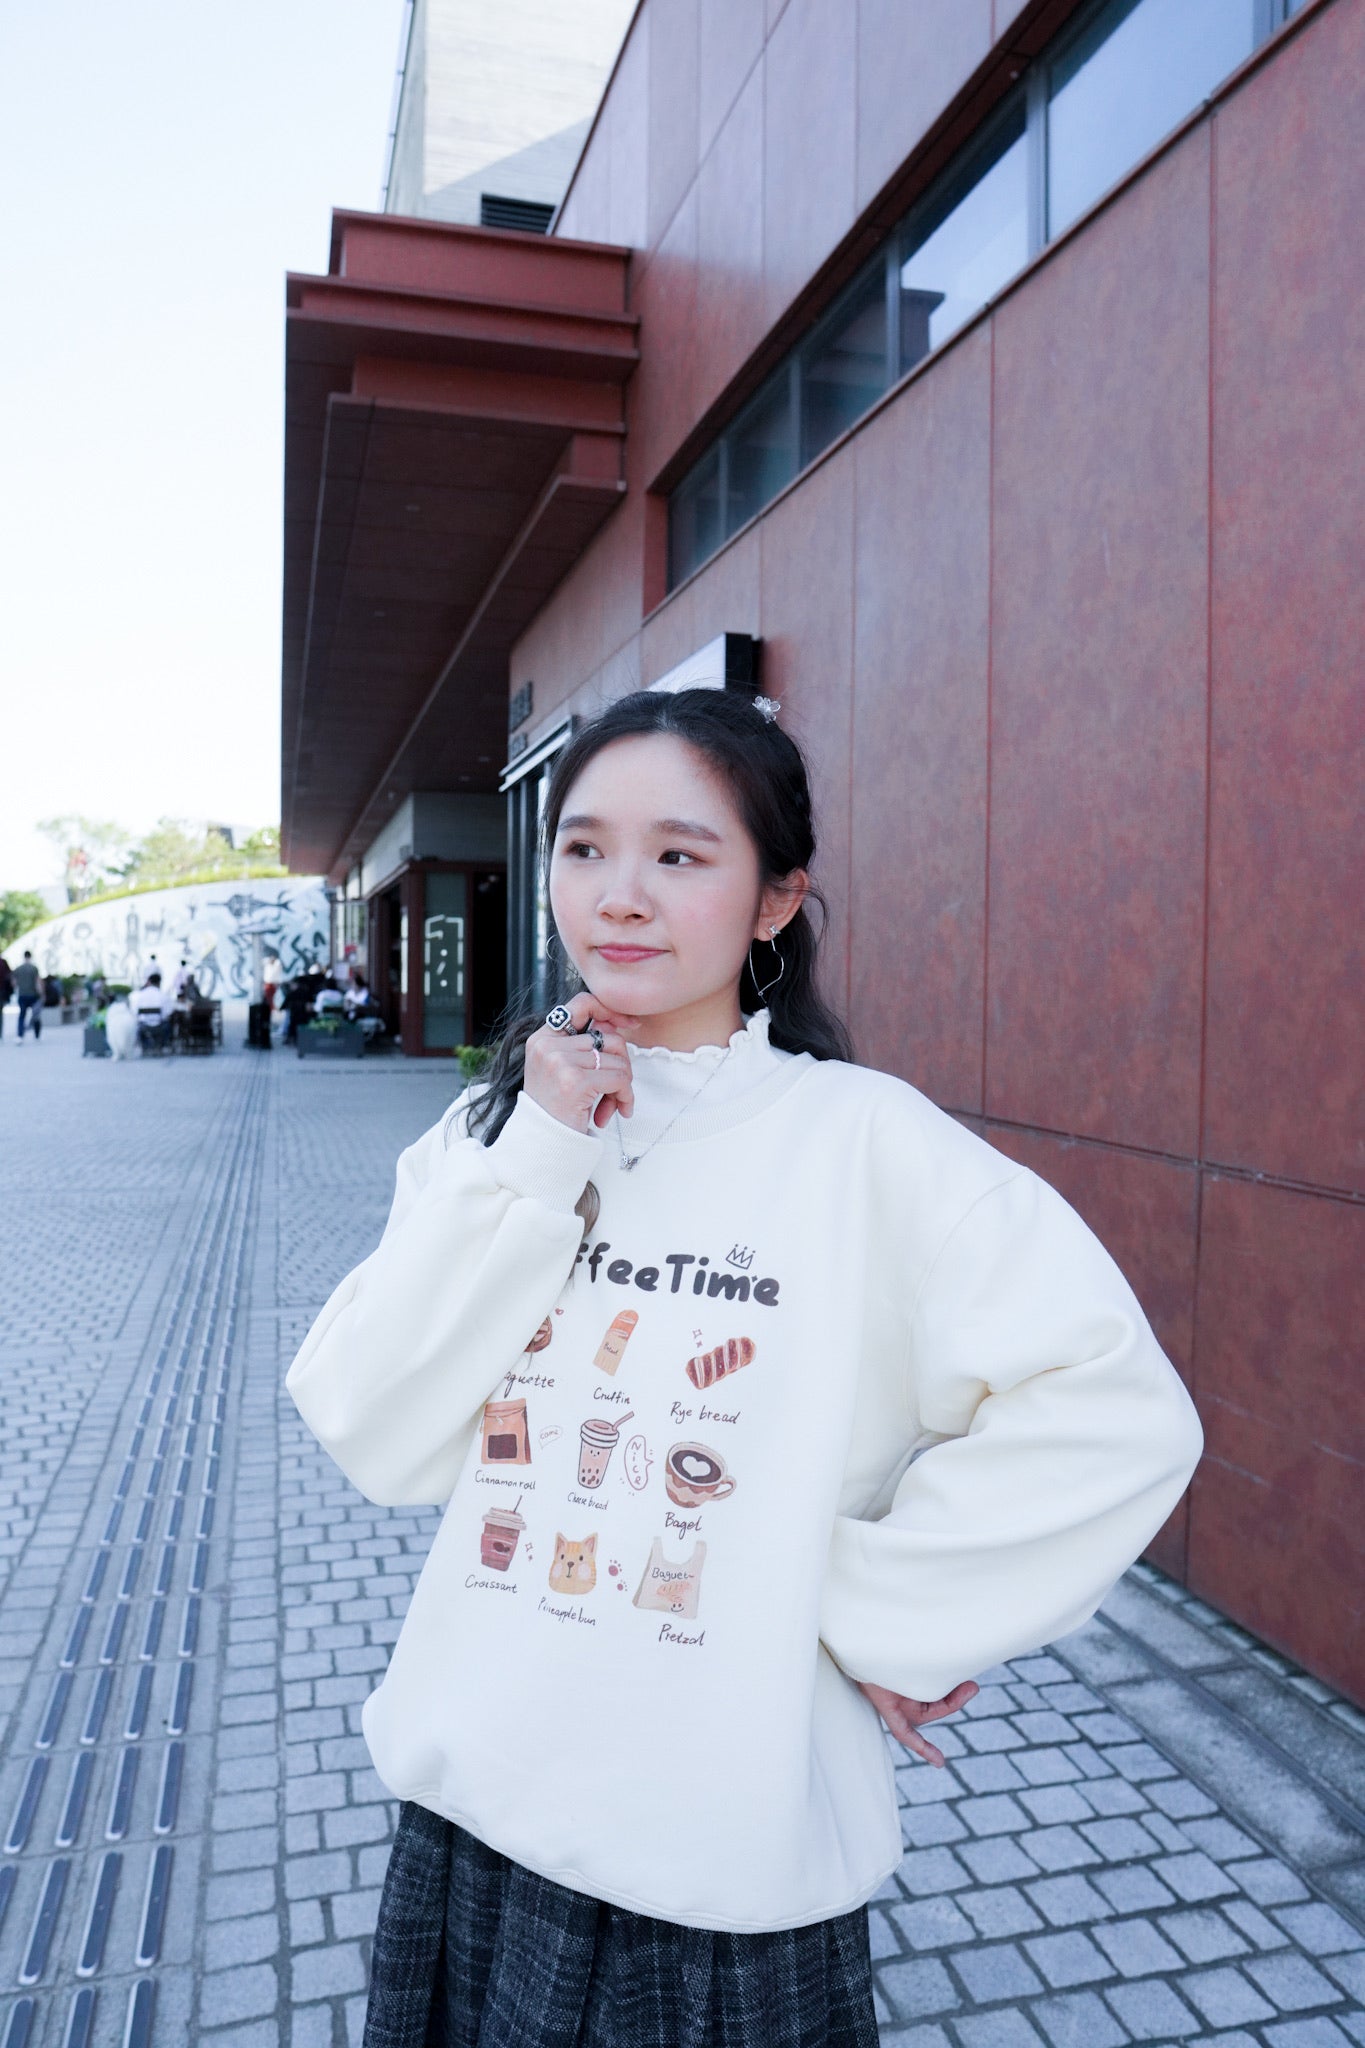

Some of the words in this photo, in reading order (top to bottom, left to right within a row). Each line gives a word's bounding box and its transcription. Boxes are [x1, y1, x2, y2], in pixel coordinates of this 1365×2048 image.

[670, 1401, 693, 1425] Rye
[699, 1404, 741, 1425] bread
[664, 1511, 703, 1540] Bagel
[464, 1574, 518, 1594] Croissant
[578, 1607, 597, 1626] bun
